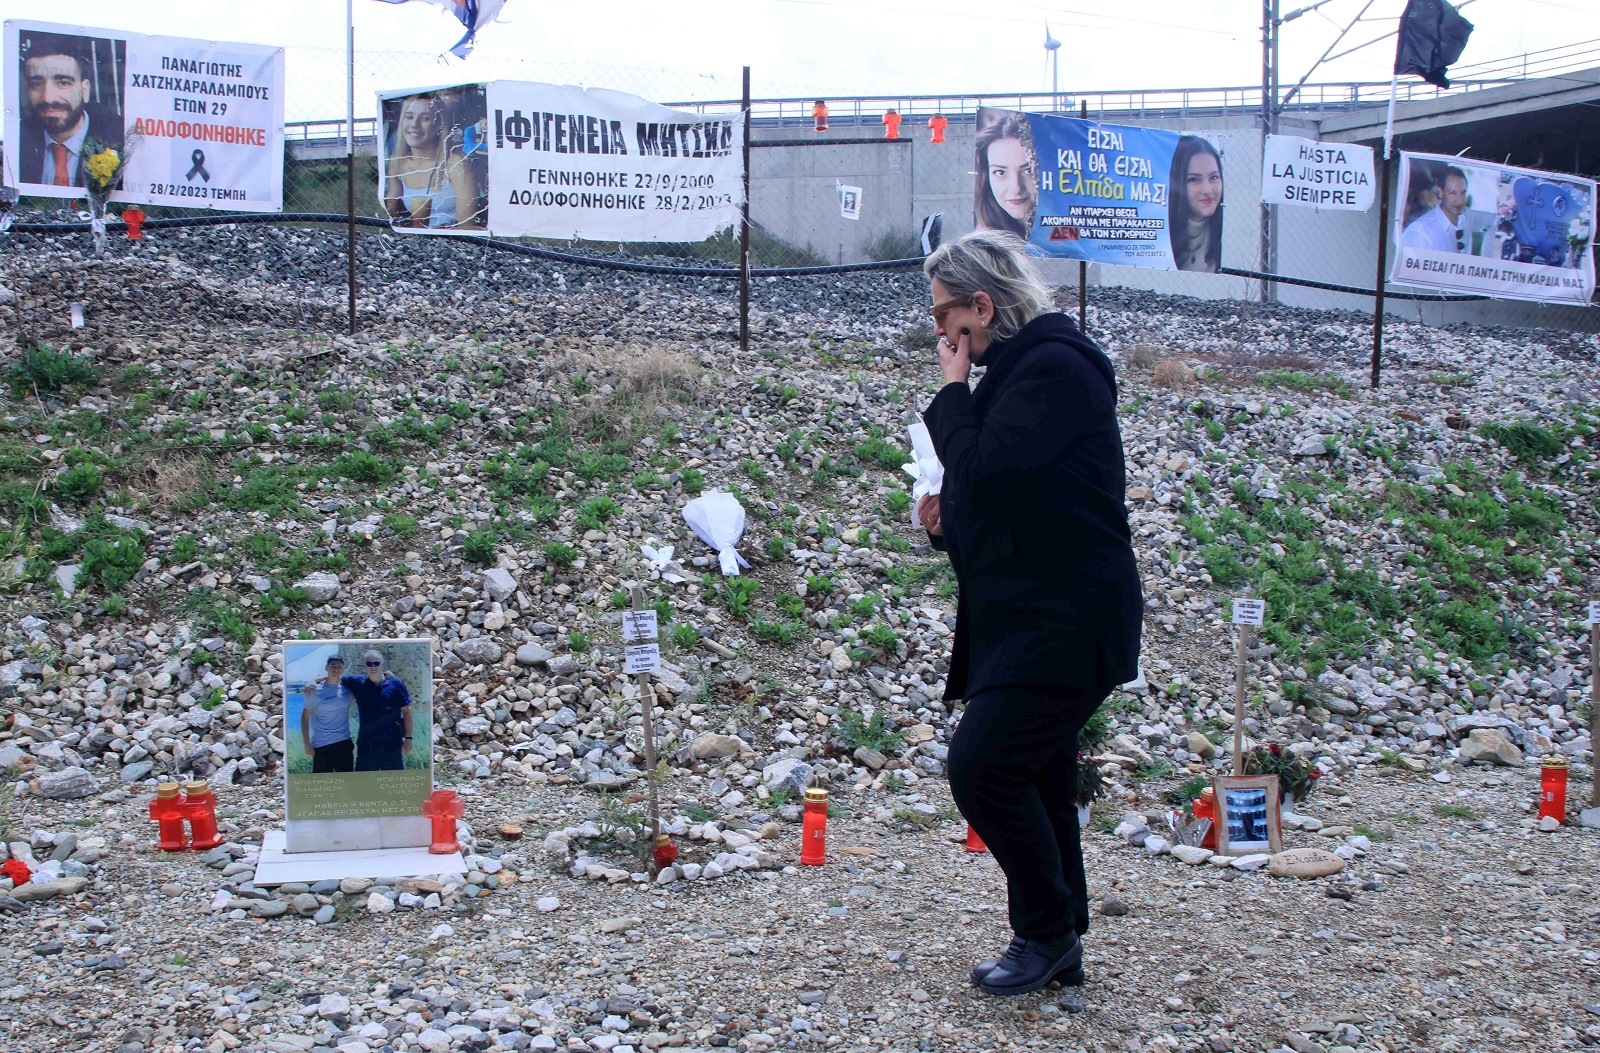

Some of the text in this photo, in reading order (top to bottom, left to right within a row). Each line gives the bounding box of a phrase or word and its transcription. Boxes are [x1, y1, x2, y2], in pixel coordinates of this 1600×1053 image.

[161, 56, 242, 78] ΠΑΝΑΓΙΩΤΗΣ
[132, 73, 269, 100] ΧΑΤΖΗΧΑΡΑΛΑΜΠΟΥΣ
[174, 97, 228, 116] ΕΤΩΝ 29
[133, 117, 266, 147] ΔΟΛΟΦΟΝΗΘΗΚΕ
[494, 109, 628, 155] ΙΦΙΓΕΝΕΙΑ
[1088, 128, 1124, 152] ΕΙΣΑΙ
[1057, 148, 1153, 179] ΚΑΙ ΘΑ ΕΙΣΑΙ
[1299, 145, 1347, 164] HASTA
[529, 168, 714, 192] ΓΕΝΝΗΘΗΚΕ 22/9/2000
[1272, 163, 1369, 186] LA JUSTICIA
[150, 183, 208, 198] 28/2/2023
[211, 188, 246, 201] ΤΕΜΠΗ
[1042, 169, 1167, 206] Η Ελπίδα ΜΑΣ!
[1285, 185, 1356, 204] SIEMPRE
[509, 189, 645, 210] ΔΟΛΟΦΟΝΗΘΗΚΕ
[1070, 206, 1082, 216] ΑΝ
[1083, 207, 1115, 217] ΥΠΑΡΧΕΙ
[1072, 217, 1086, 226] ΚΑΙ
[1086, 218, 1099, 227] ΝΑ
[1099, 218, 1111, 227] ΜΕ
[1051, 226, 1080, 240] ΔΕΝ
[1080, 228, 1091, 238] ΘΑ
[1091, 229, 1110, 238] ΤΟΝ
[1406, 258, 1584, 290] ΘΑ ΕΙΣΑΙ ΓΙΑ ΠΑΝΤΑ ΣΤΗΝ ΚΑΡΔΙΑ ΜΑΣ
